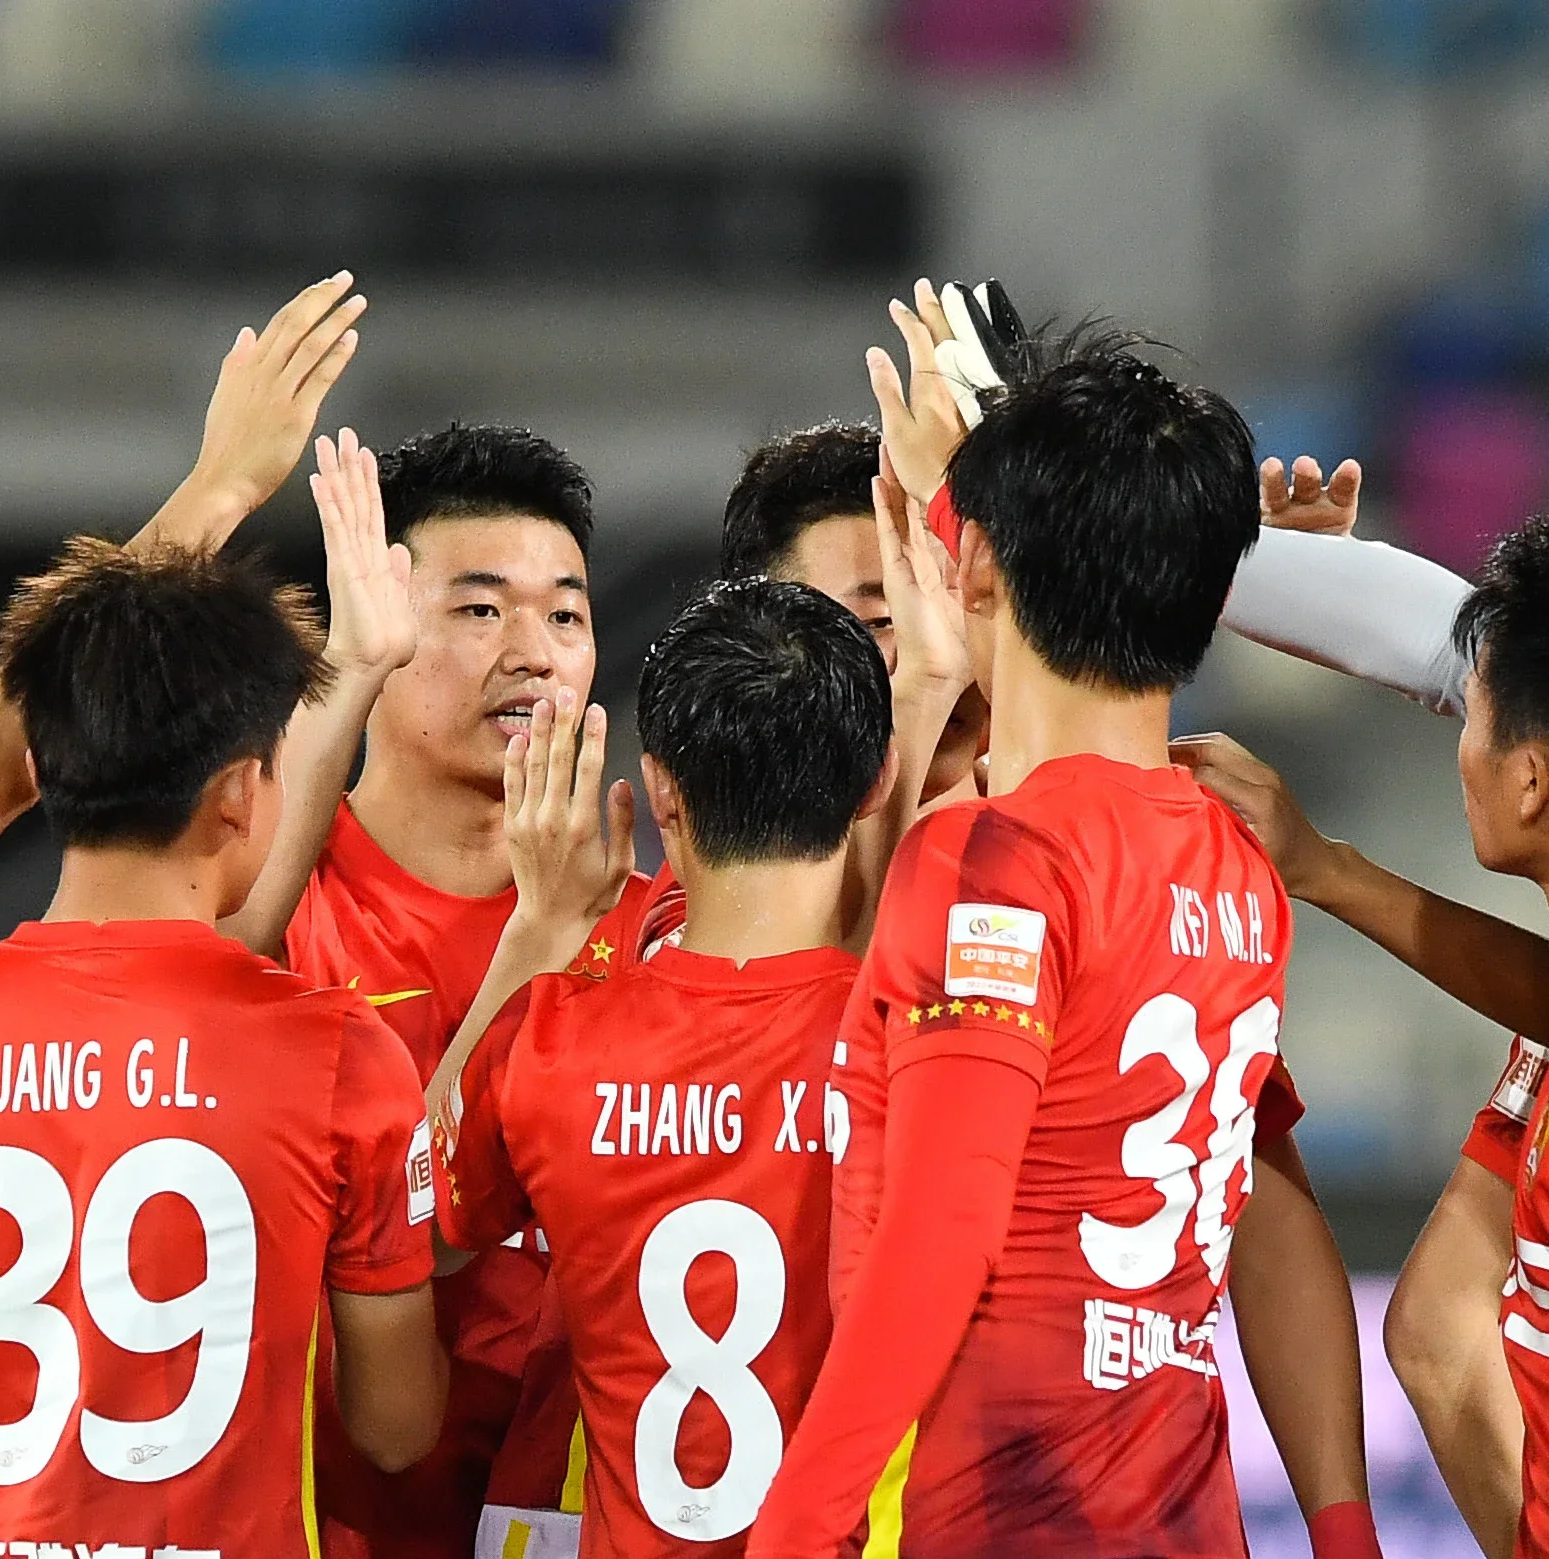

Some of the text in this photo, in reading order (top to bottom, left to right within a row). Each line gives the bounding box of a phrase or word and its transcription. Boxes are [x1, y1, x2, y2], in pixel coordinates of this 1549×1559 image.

[1215, 890, 1274, 965] M.H.
[125, 1036, 219, 1111] G.L.
[590, 1081, 744, 1157] ZHANG
[634, 1198, 787, 1542] 8
